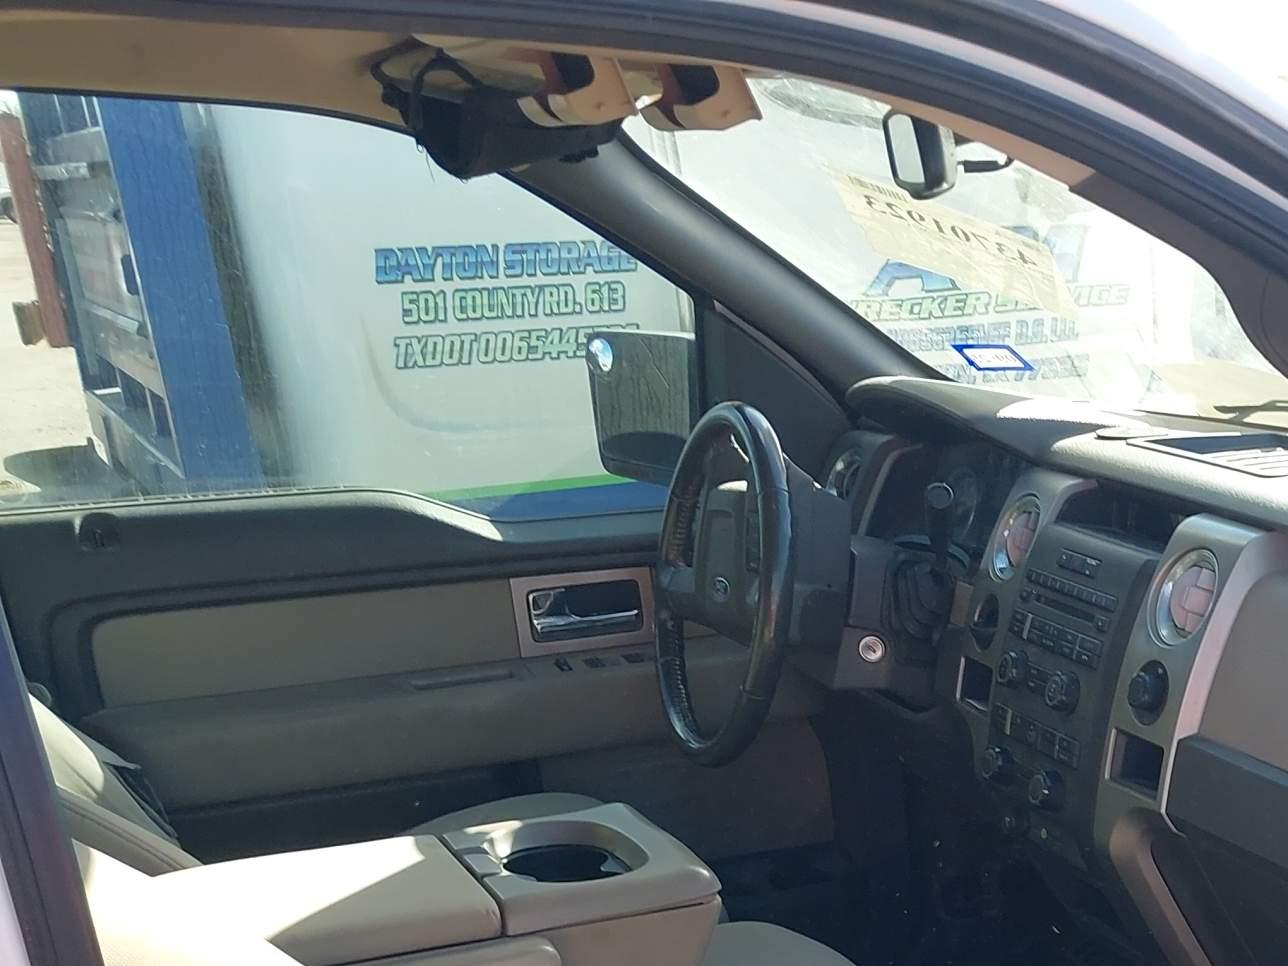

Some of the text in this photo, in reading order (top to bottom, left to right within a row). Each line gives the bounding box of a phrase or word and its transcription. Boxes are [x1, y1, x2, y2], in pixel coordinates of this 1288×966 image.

[374, 245, 500, 284] DAYTON
[401, 280, 627, 324] 501 COUNTY RD. 613
[849, 290, 992, 322] RECKER
[394, 332, 478, 370] TXDOT
